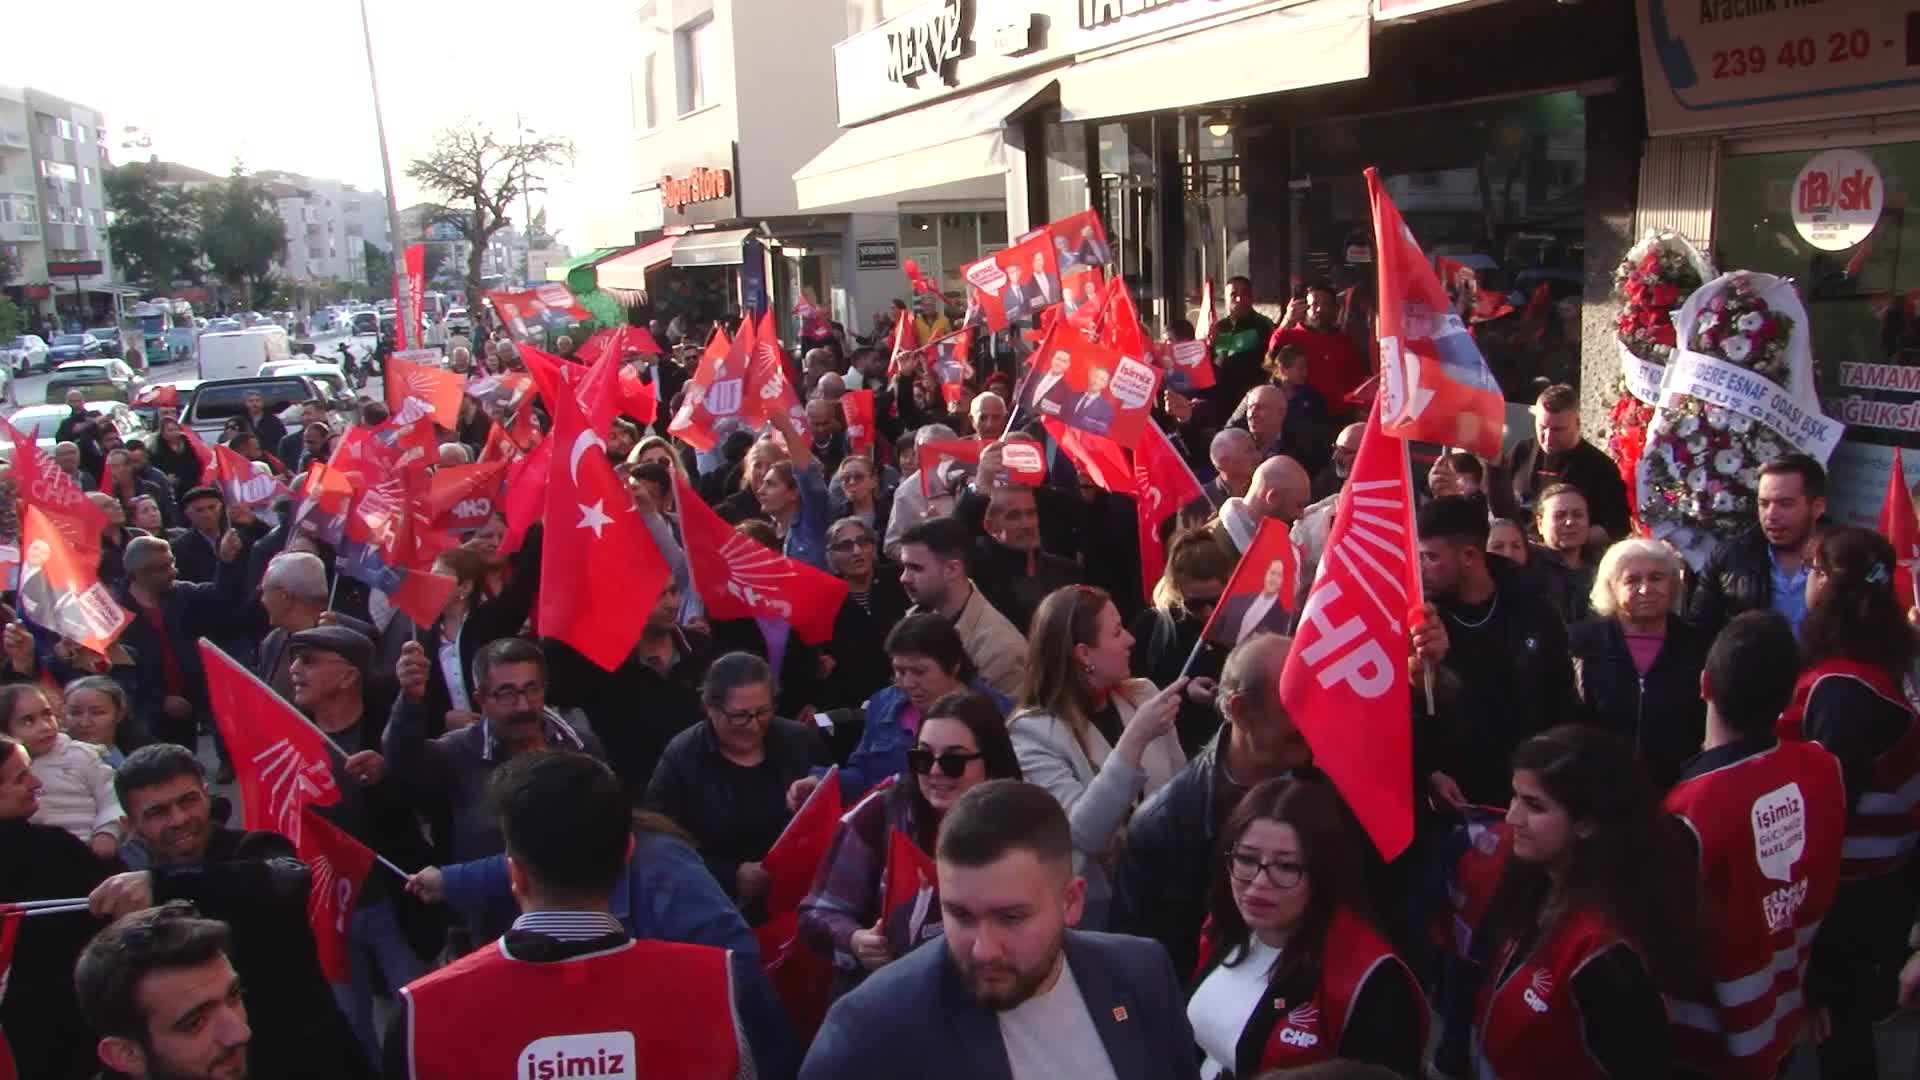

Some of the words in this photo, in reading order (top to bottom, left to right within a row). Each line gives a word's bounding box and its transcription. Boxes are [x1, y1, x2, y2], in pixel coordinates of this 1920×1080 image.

[1712, 46, 1767, 80] 239
[1777, 37, 1816, 68] 40
[1828, 28, 1871, 63] 20
[1726, 372, 1769, 400] ESNAF
[1843, 396, 1893, 427] ĞLIK
[1298, 579, 1396, 699] HP
[1756, 796, 1800, 829] işimiz
[1524, 987, 1549, 1013] CHP
[1280, 1028, 1318, 1048] CHP
[527, 1047, 625, 1080] işimiz
